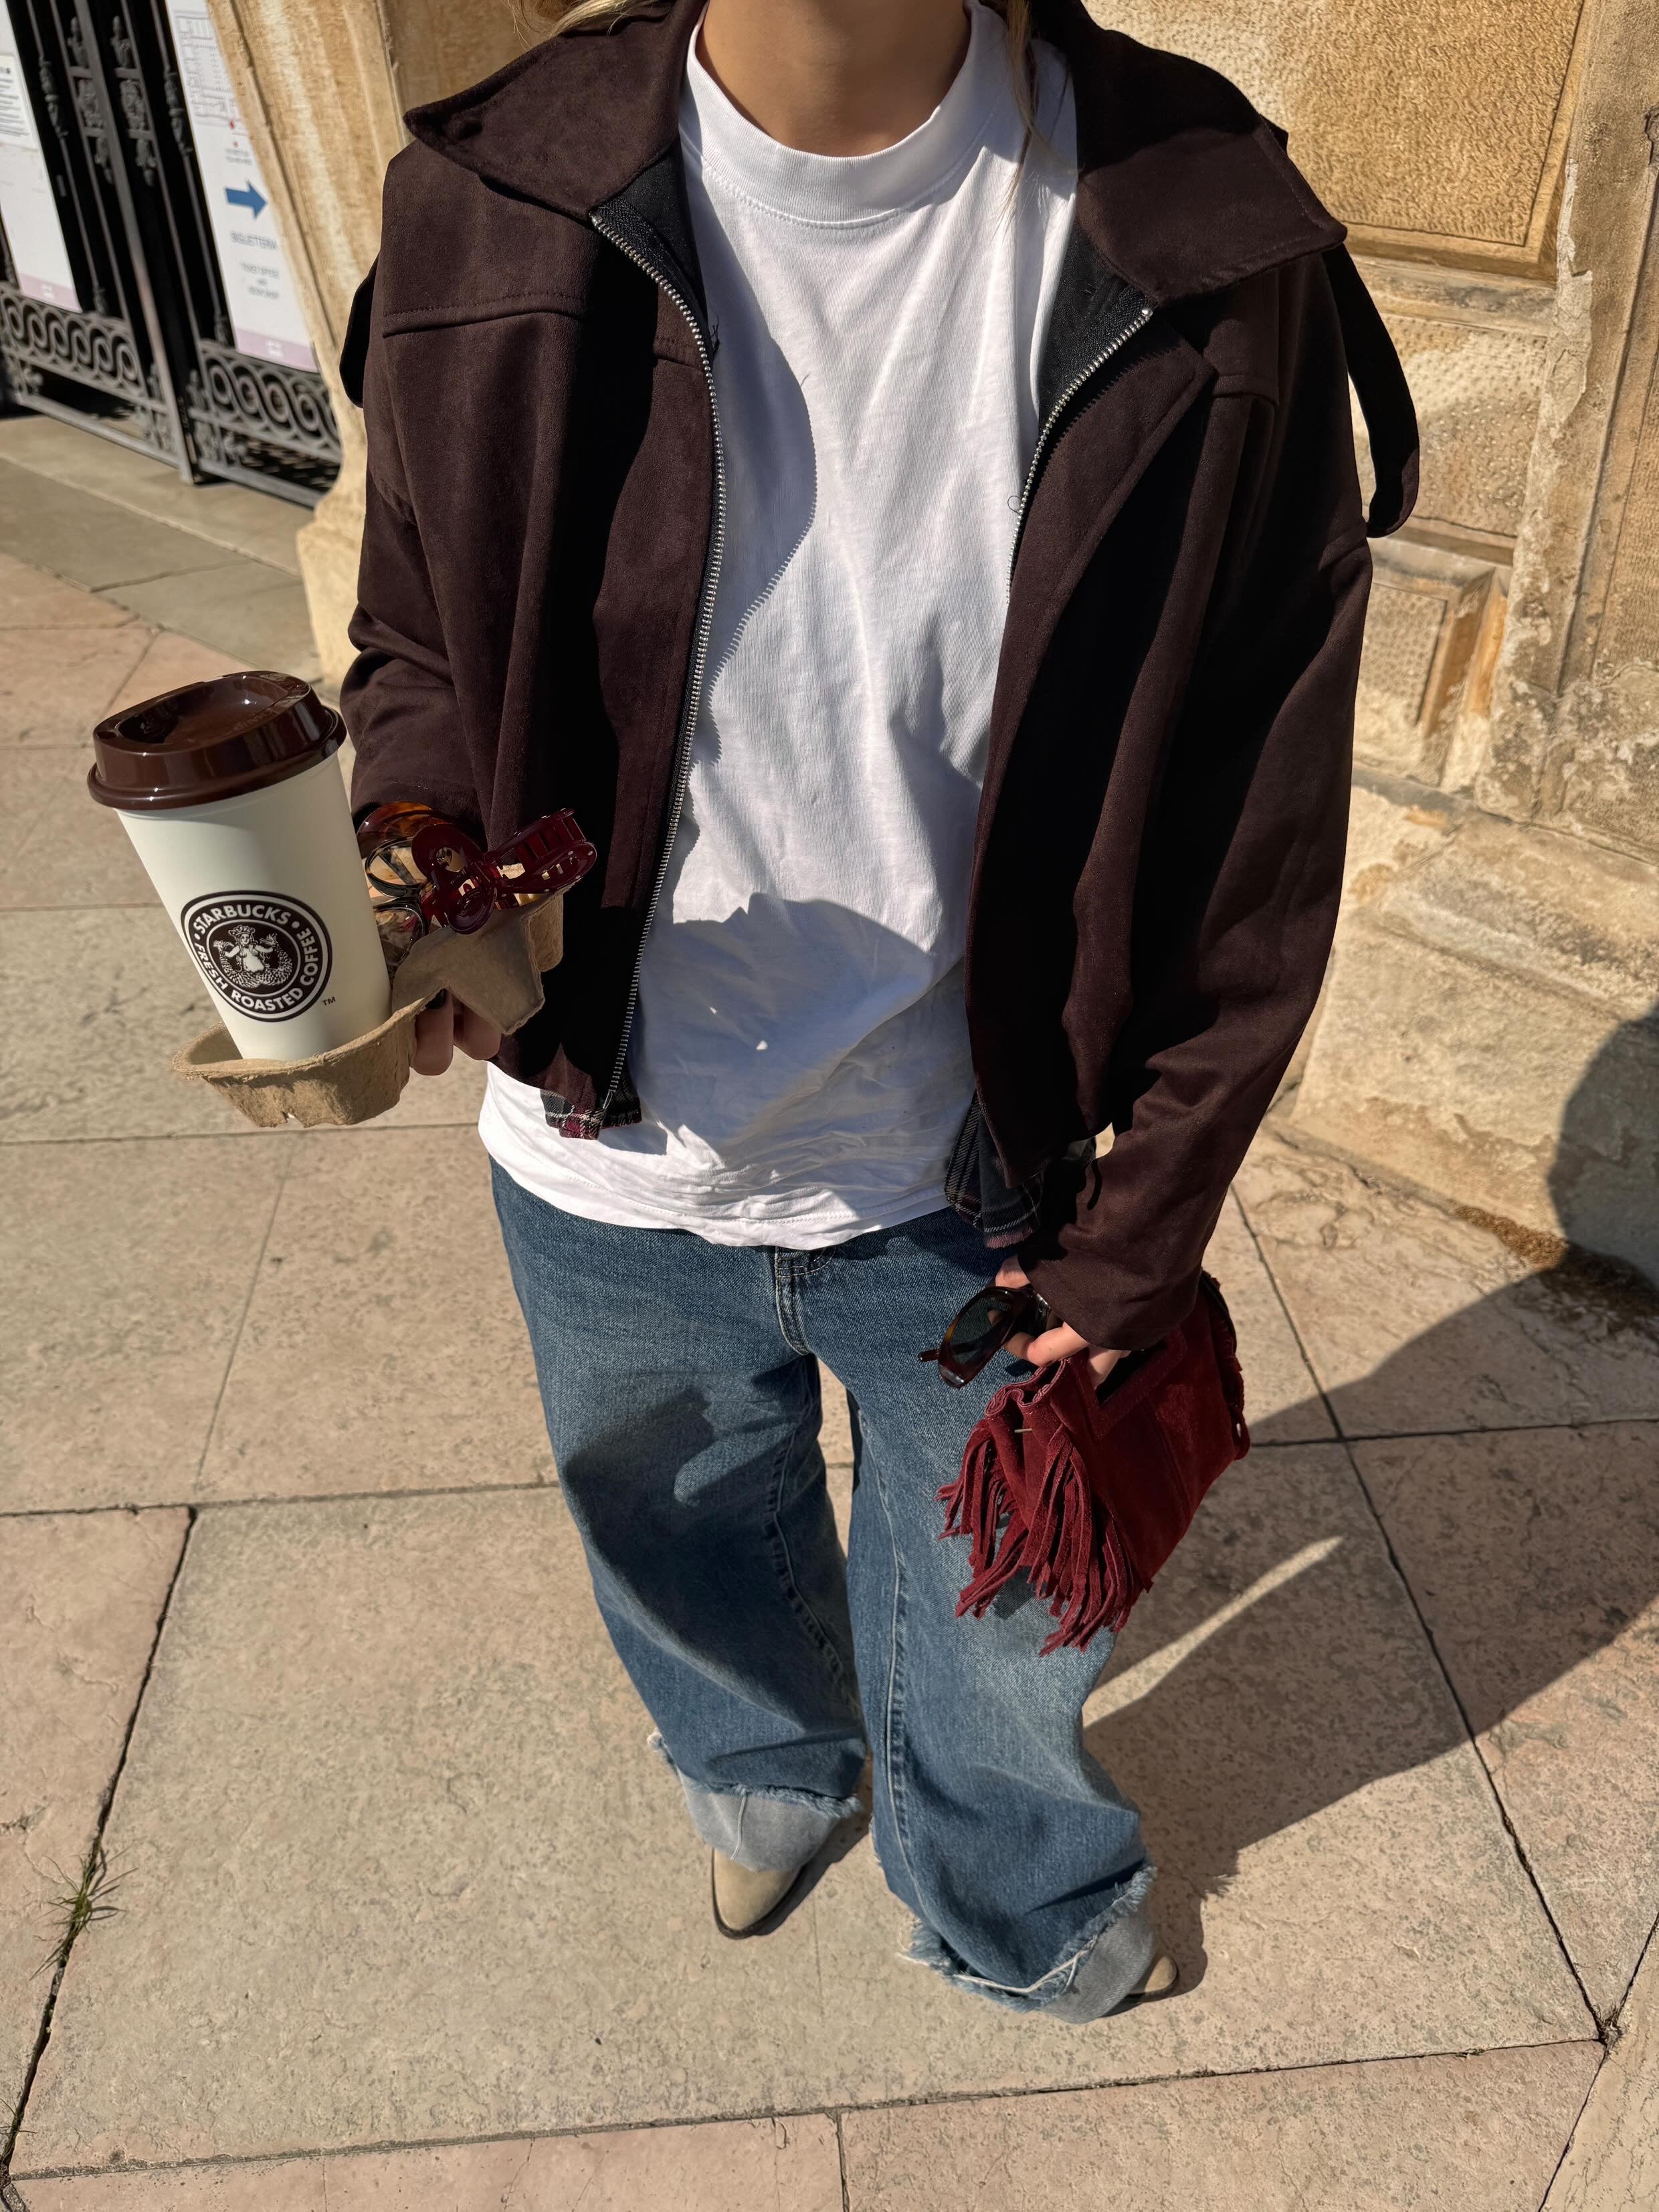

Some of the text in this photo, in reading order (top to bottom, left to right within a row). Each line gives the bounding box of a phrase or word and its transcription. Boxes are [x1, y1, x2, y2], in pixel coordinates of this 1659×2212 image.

[193, 904, 292, 935] STARBUCKS
[194, 928, 318, 1011] FRESH ROASTED COFFEE
